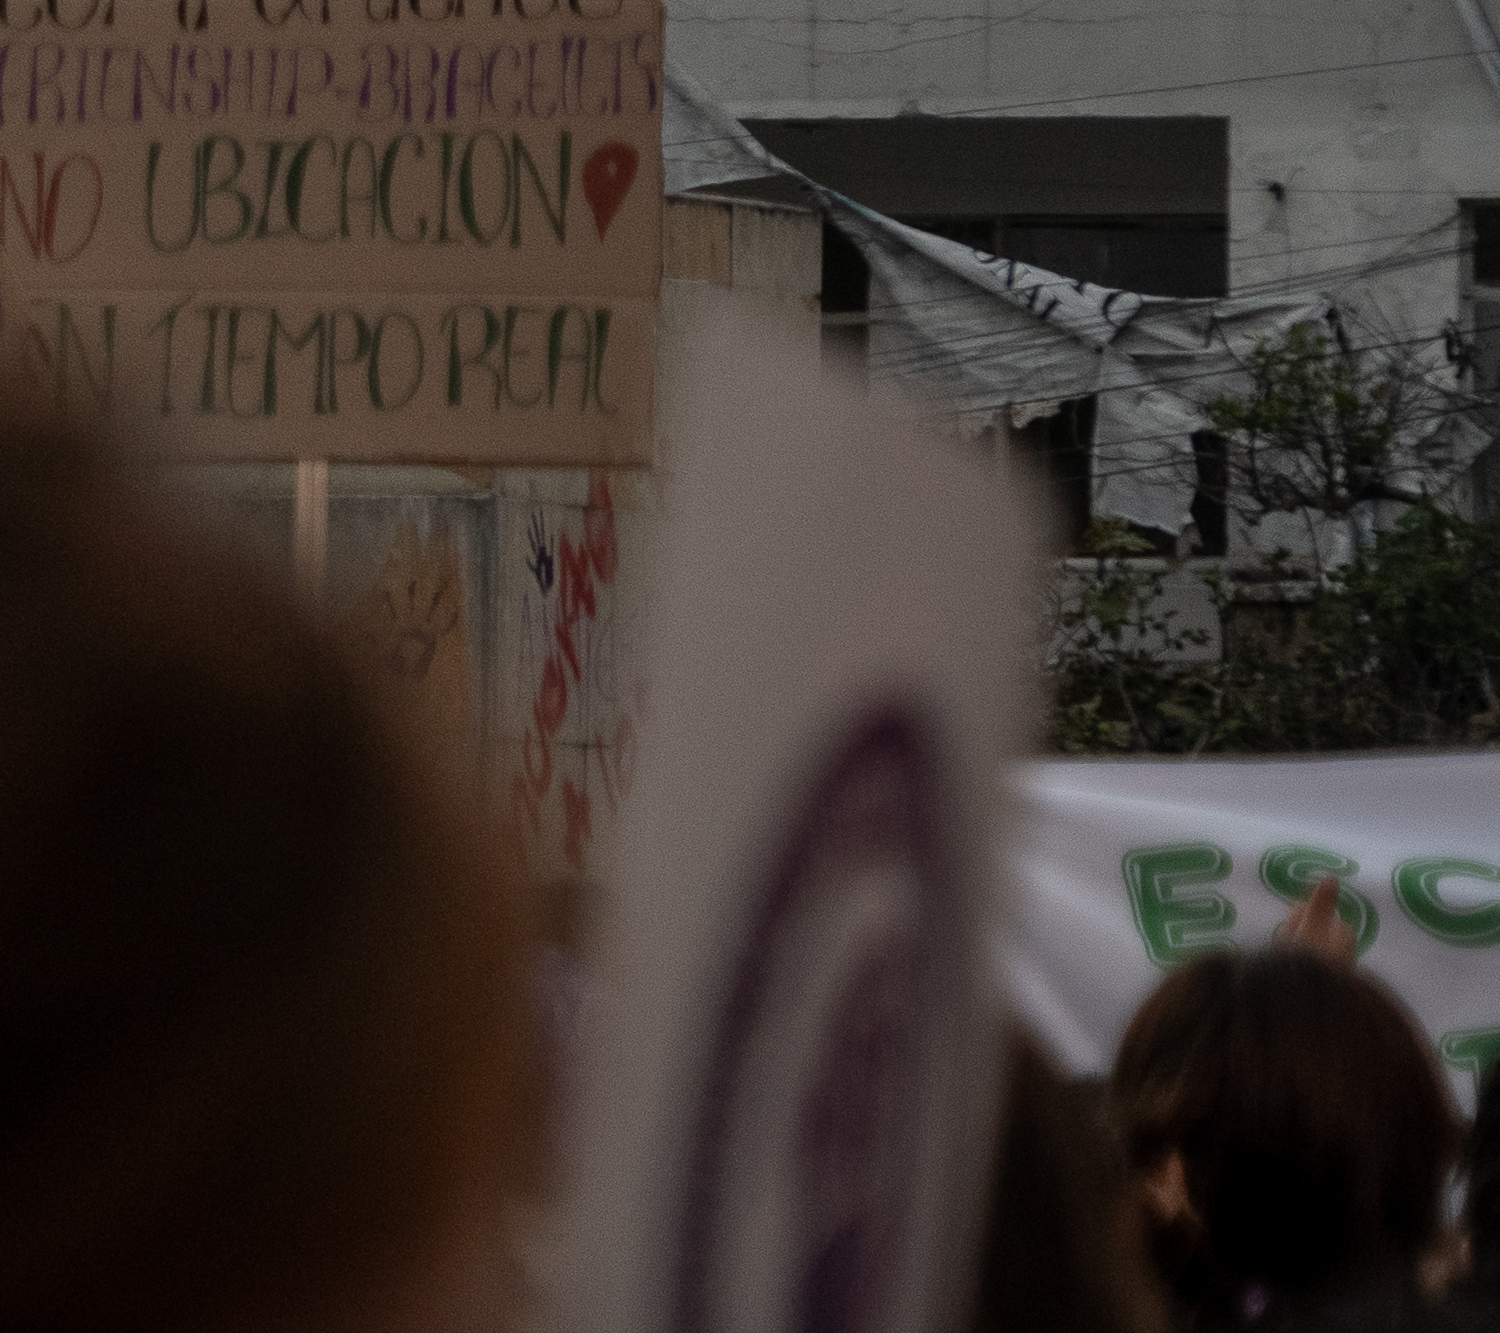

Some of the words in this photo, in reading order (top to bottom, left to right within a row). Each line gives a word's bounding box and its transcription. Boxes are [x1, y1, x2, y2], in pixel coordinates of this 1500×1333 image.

[144, 129, 573, 255] UBICACION
[147, 293, 425, 420] TIEMPO
[441, 303, 620, 415] REAL
